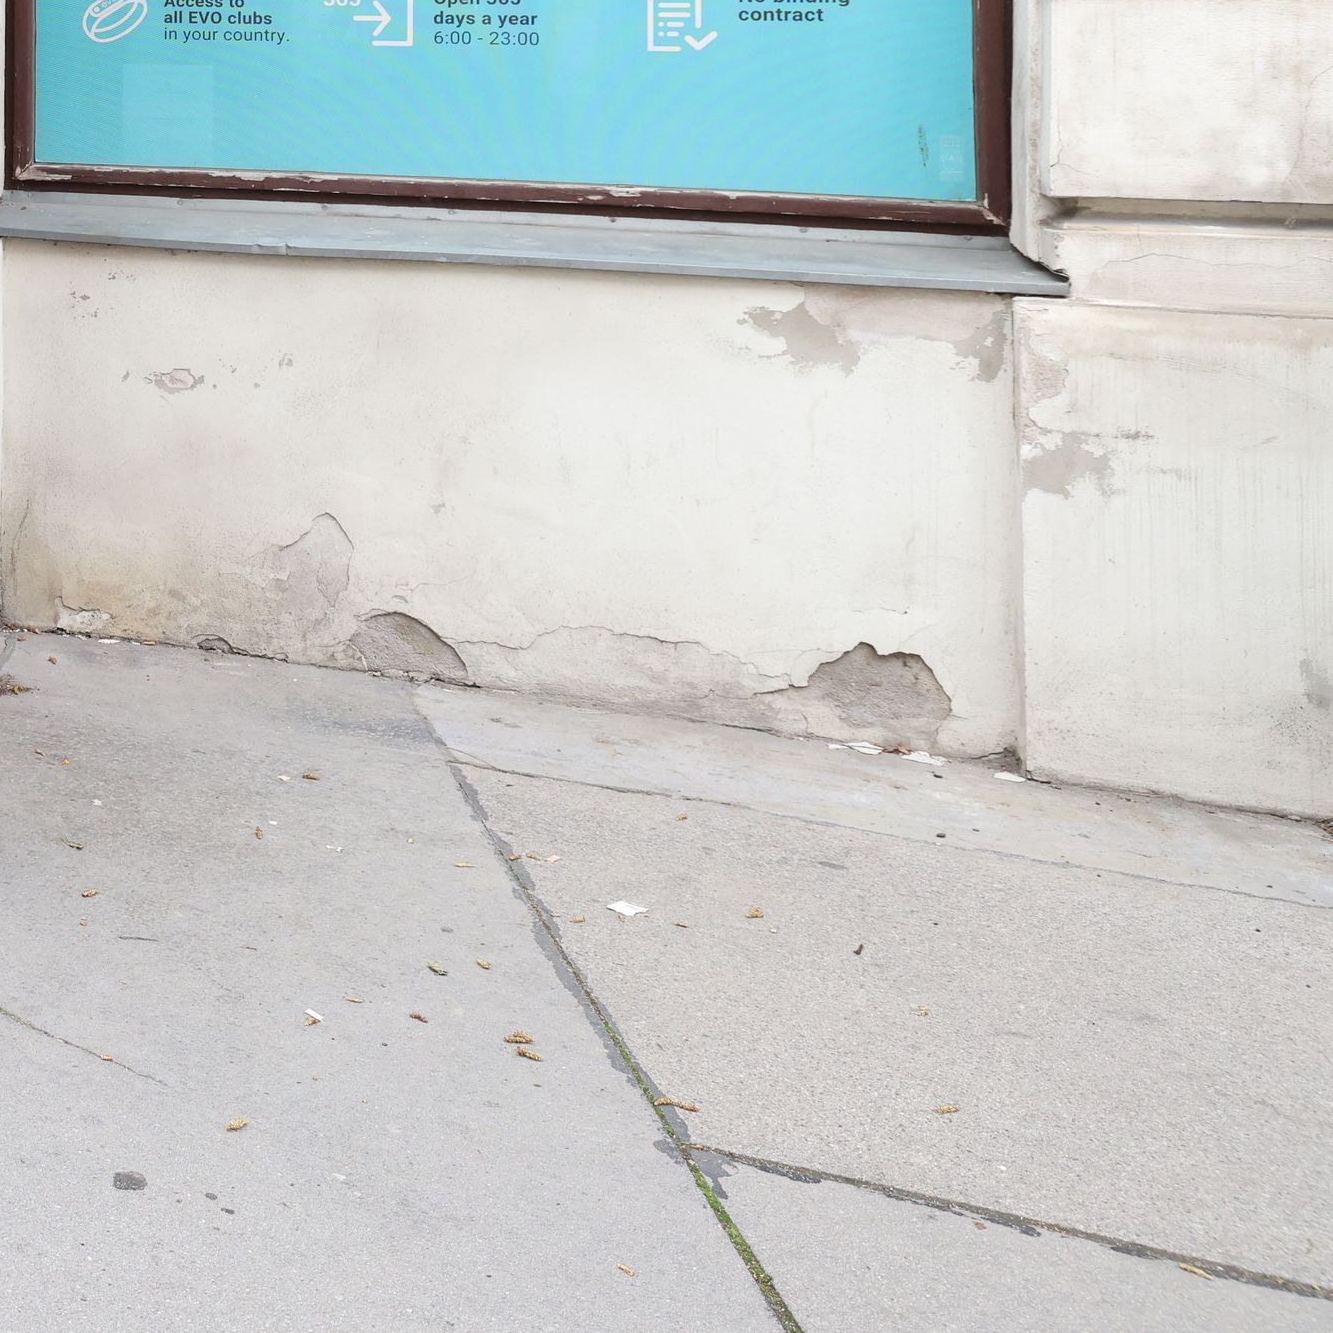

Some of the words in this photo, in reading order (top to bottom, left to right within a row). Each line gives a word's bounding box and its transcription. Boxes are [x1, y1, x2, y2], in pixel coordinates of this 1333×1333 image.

[163, 11, 183, 24] all
[188, 11, 222, 25] EVO
[227, 11, 273, 25] clubs
[433, 11, 476, 28] days
[481, 14, 492, 26] a
[498, 14, 538, 28] year
[738, 8, 824, 22] contract
[163, 27, 178, 41] in
[182, 29, 219, 44] your
[223, 29, 290, 45] country.
[433, 31, 472, 45] 6:00
[488, 31, 540, 46] 23:00
